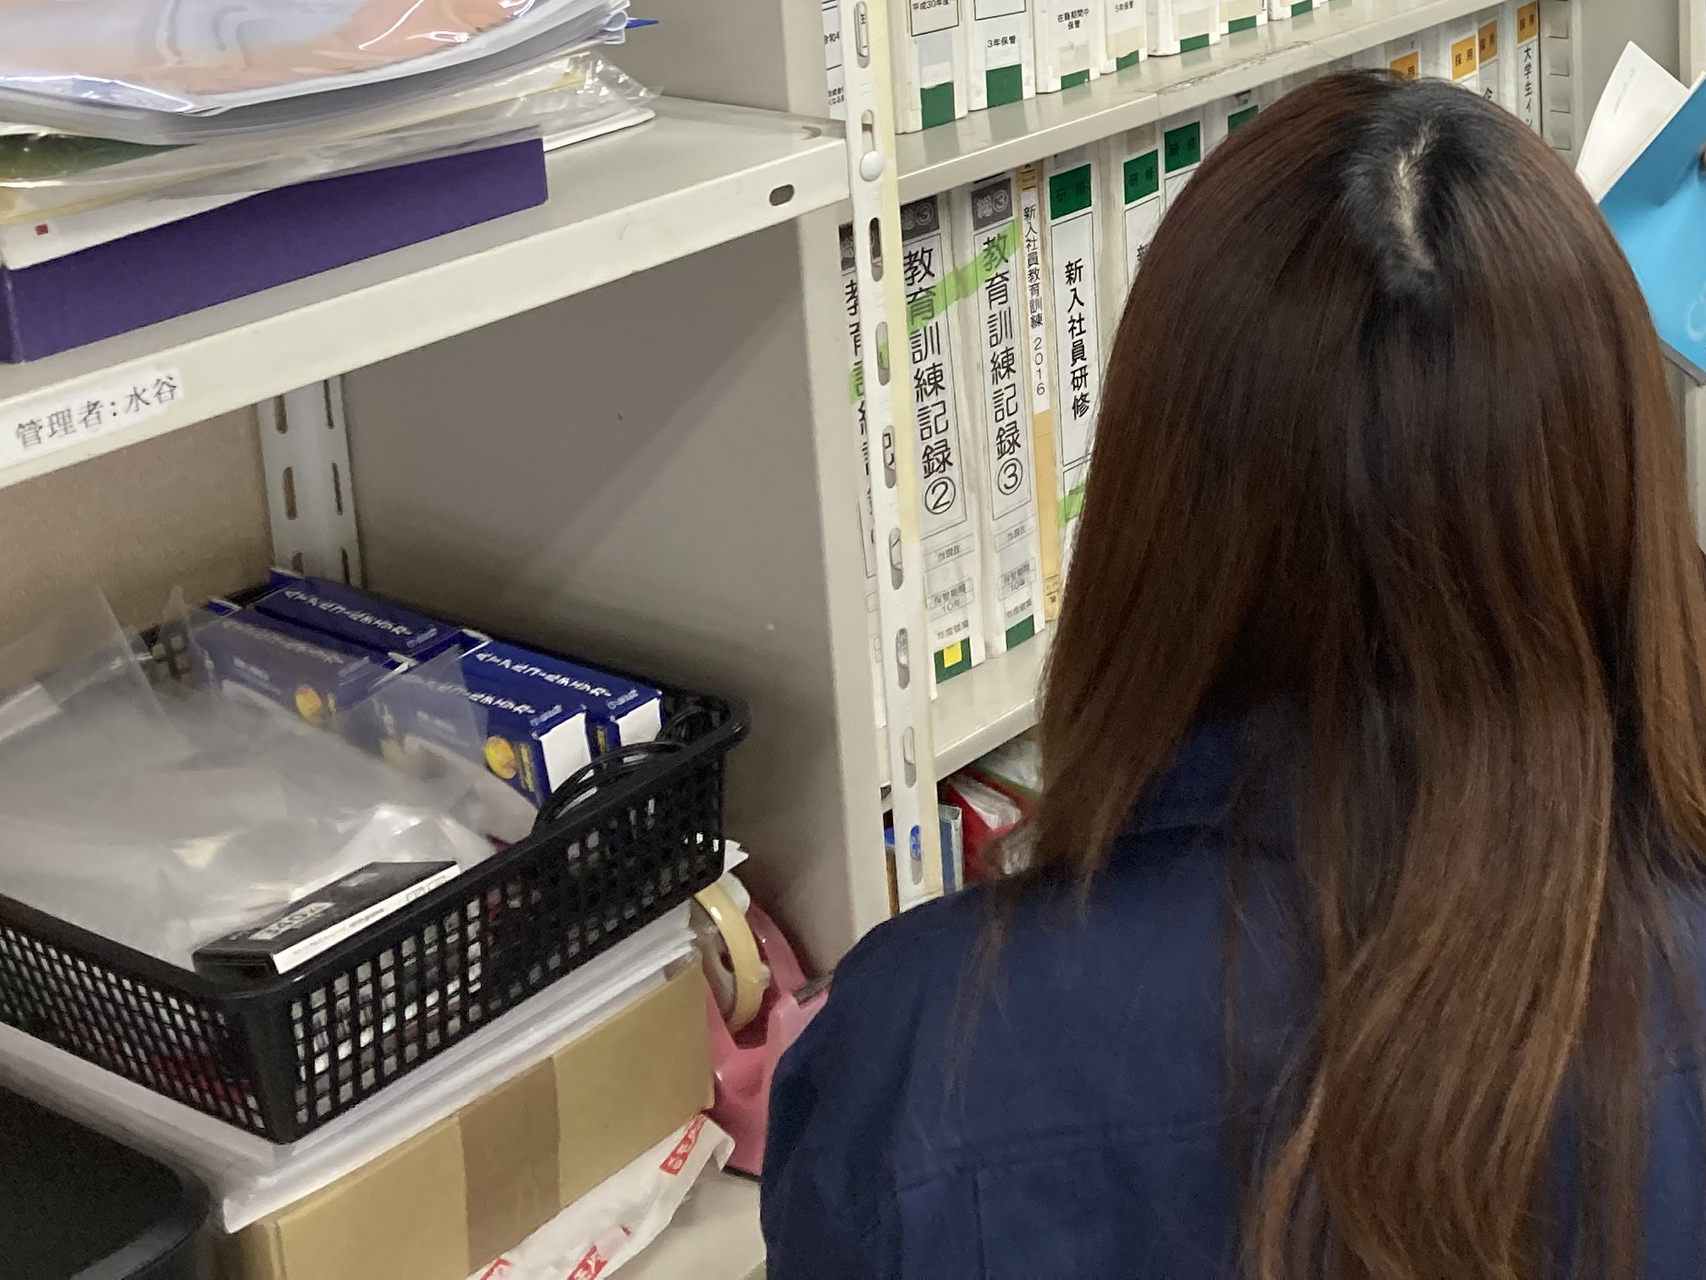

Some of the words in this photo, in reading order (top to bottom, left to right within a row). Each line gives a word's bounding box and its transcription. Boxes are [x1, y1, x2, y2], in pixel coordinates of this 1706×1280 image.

[986, 33, 1018, 50] 3年保管
[1023, 204, 1044, 329] 新入社員教育訓練
[903, 245, 957, 516] 教育訓練記録②
[981, 232, 1024, 497] 教育訓練記録③
[1033, 336, 1046, 397] 2016
[1064, 257, 1091, 422] 新入社員研修
[14, 373, 181, 449] 管理者:水谷
